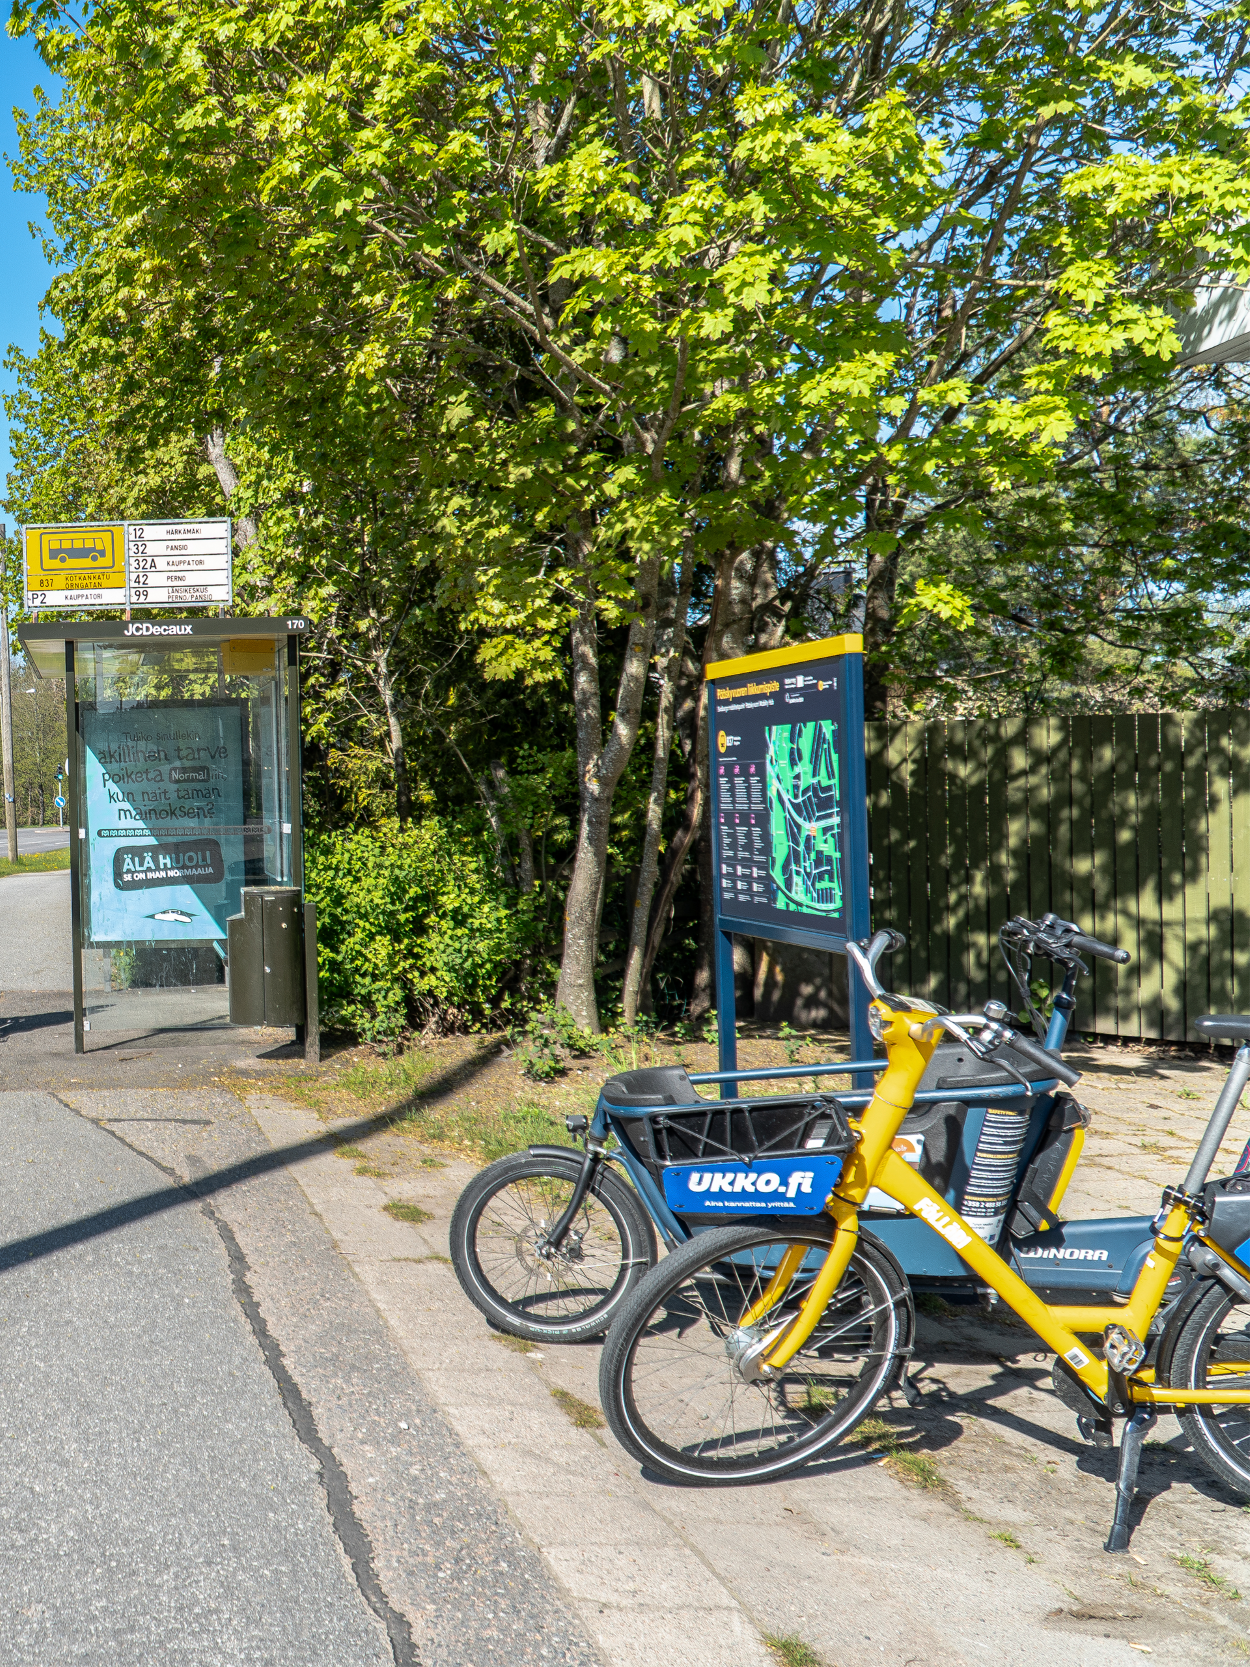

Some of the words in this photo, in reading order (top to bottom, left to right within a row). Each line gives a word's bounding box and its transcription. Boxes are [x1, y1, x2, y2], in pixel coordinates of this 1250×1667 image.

[133, 527, 145, 539] 12
[133, 543, 147, 555] 32
[134, 558, 157, 570] 32A
[167, 559, 205, 567] KAUPPATORI
[39, 579, 54, 588] 837
[65, 574, 111, 582] KOTKANKATU
[134, 574, 149, 585] 42
[31, 593, 47, 604] P2
[65, 593, 103, 601] KAUPPATORI
[134, 590, 149, 601] 99
[124, 623, 193, 636] JCDecaux
[286, 620, 305, 629] 170
[122, 731, 152, 741] Tuliko
[156, 730, 201, 740] sinullekin
[98, 744, 169, 764] äkillinen
[174, 745, 228, 761] tarve
[102, 768, 164, 788] poiketa
[108, 789, 135, 803] kun
[142, 787, 170, 802] näit
[174, 786, 221, 800] tämän
[118, 802, 215, 820] mainoksen?
[123, 852, 156, 872] ÄLÄ
[159, 851, 211, 869] HUOLI
[133, 872, 146, 880] ON
[147, 870, 166, 879] IHAN
[167, 867, 214, 877] NORMAALIA
[688, 1171, 814, 1198] UKKO.fi
